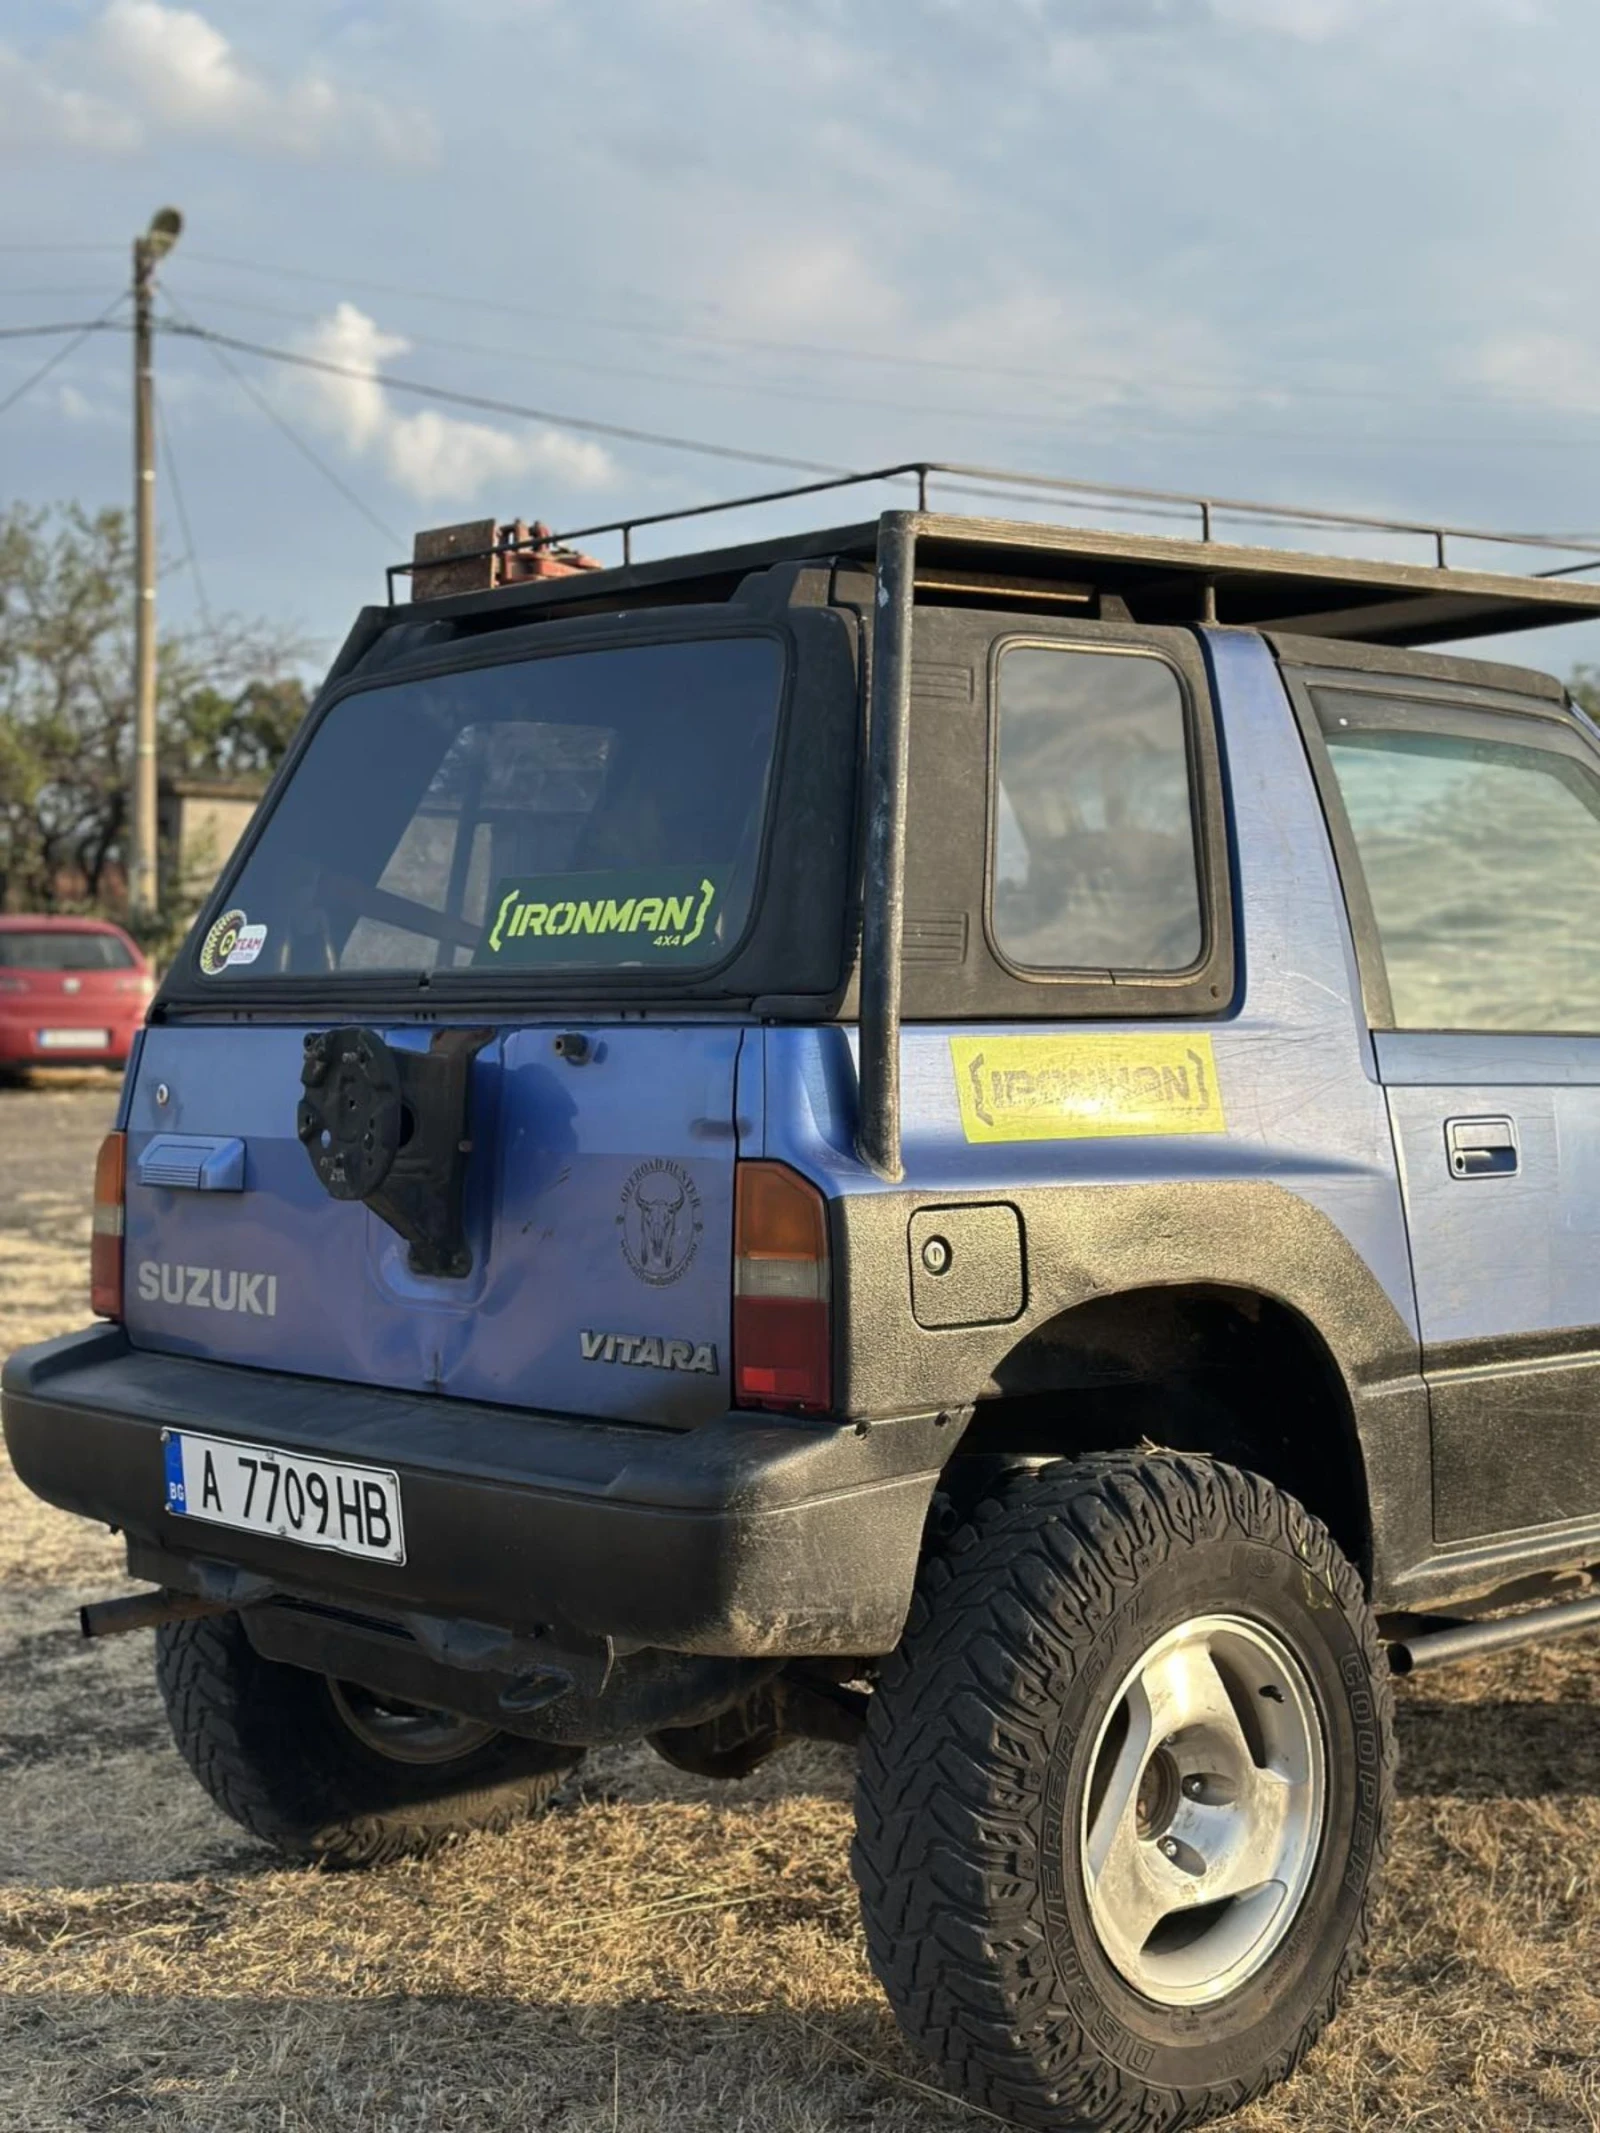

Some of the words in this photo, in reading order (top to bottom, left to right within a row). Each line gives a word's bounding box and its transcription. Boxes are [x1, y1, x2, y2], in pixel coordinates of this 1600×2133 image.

[507, 896, 694, 937] IRONMAN
[138, 1260, 277, 1316] SUZUKI
[580, 1330, 719, 1375] VITARA
[169, 1482, 185, 1501] BG
[202, 1450, 223, 1512] A
[1340, 1653, 1378, 1896] COOPER
[1043, 1722, 1156, 2076] DISCOVERER
